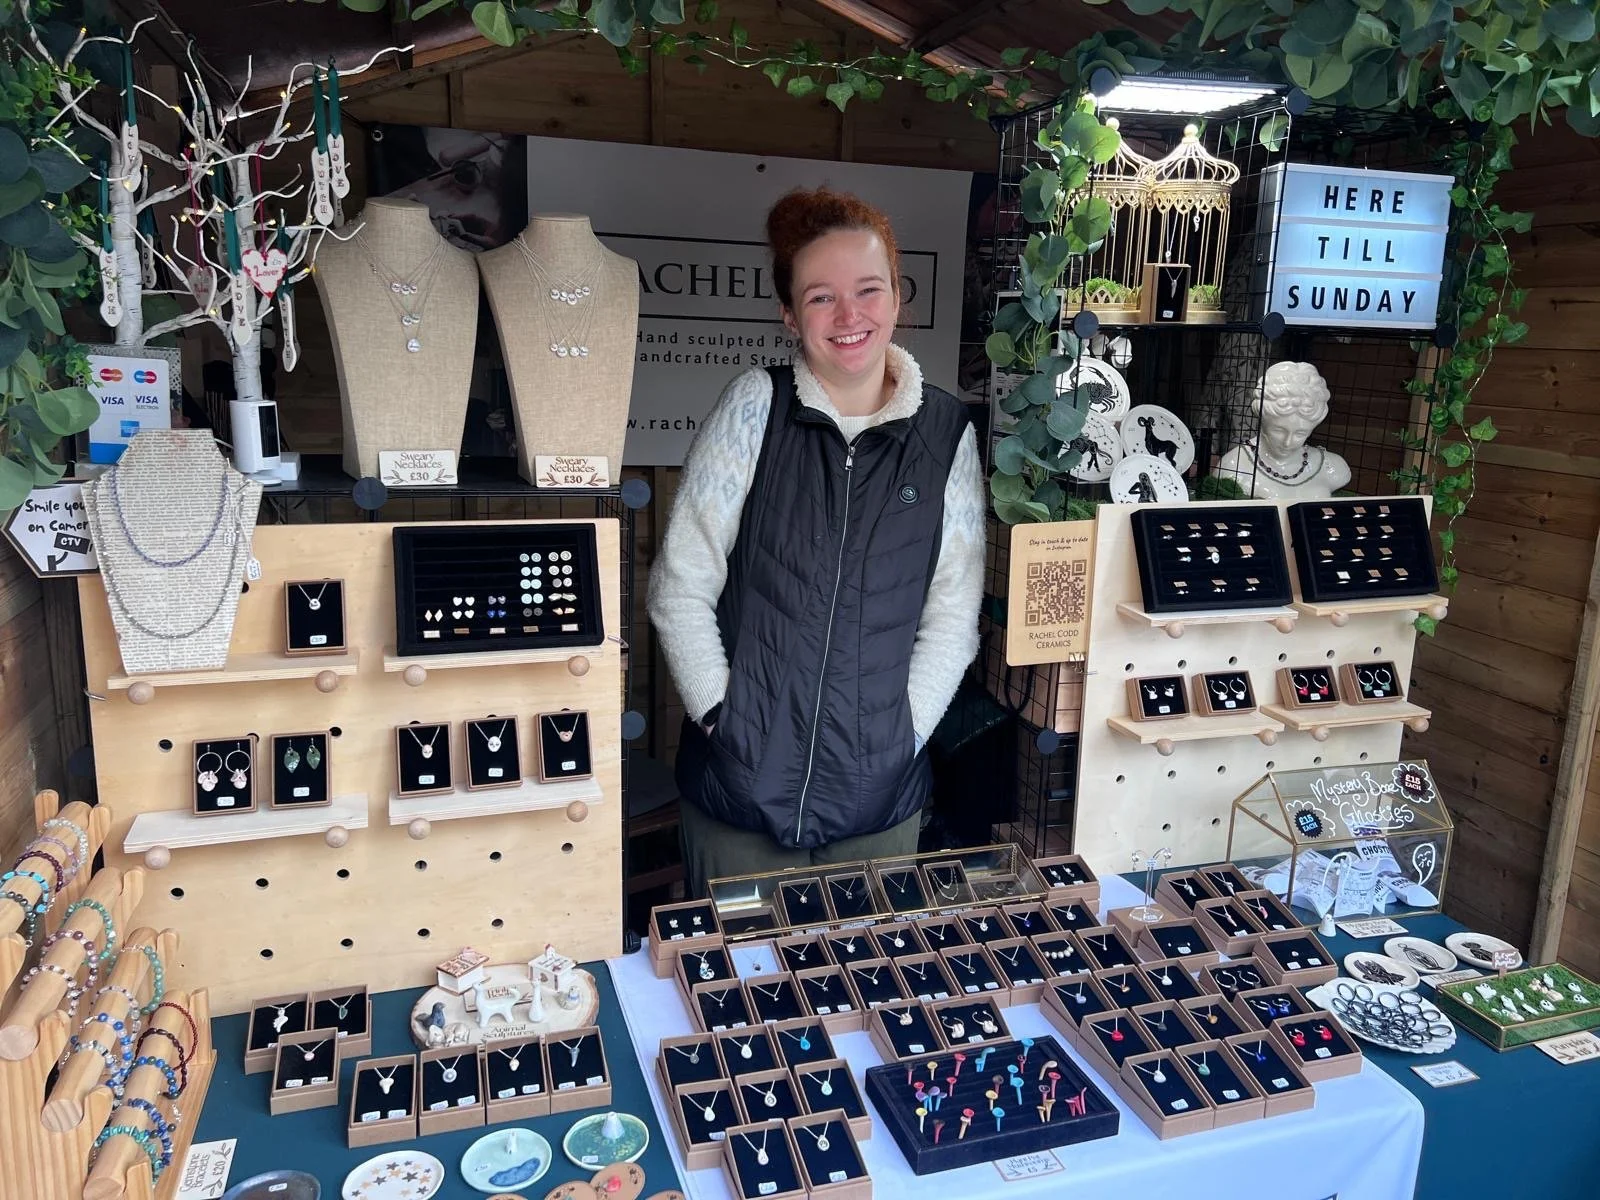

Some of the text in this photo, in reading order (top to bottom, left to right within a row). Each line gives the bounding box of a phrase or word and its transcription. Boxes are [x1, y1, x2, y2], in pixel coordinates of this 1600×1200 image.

[1324, 185, 1404, 213] HERE
[1318, 236, 1394, 263] TILL
[1288, 285, 1416, 313] SUNDAY
[688, 332, 765, 349] sculpted
[634, 351, 793, 367] andcrafted Sterl
[101, 395, 159, 405] VISA VISA
[400, 452, 436, 461] Sweary
[555, 456, 588, 465] Sweary
[394, 460, 443, 469] Necklaces
[549, 464, 596, 473] Necklaces
[410, 472, 430, 481] £30
[564, 475, 583, 484] £30
[25, 499, 60, 513] Smile
[28, 523, 45, 533] on
[1029, 629, 1079, 640] RACHEL CODD
[1036, 640, 1071, 649] CERAMICS
[1405, 773, 1421, 785] £15
[1405, 782, 1421, 791] EACH
[1310, 778, 1369, 807] Mystery
[1299, 814, 1313, 825] £15
[1340, 802, 1414, 827] Ghosties
[1302, 822, 1318, 832] EACH
[492, 1024, 526, 1033] Animal
[180, 1153, 200, 1192] Gemstone
[193, 1153, 211, 1189] Bracelets
[212, 1160, 226, 1176] £20
